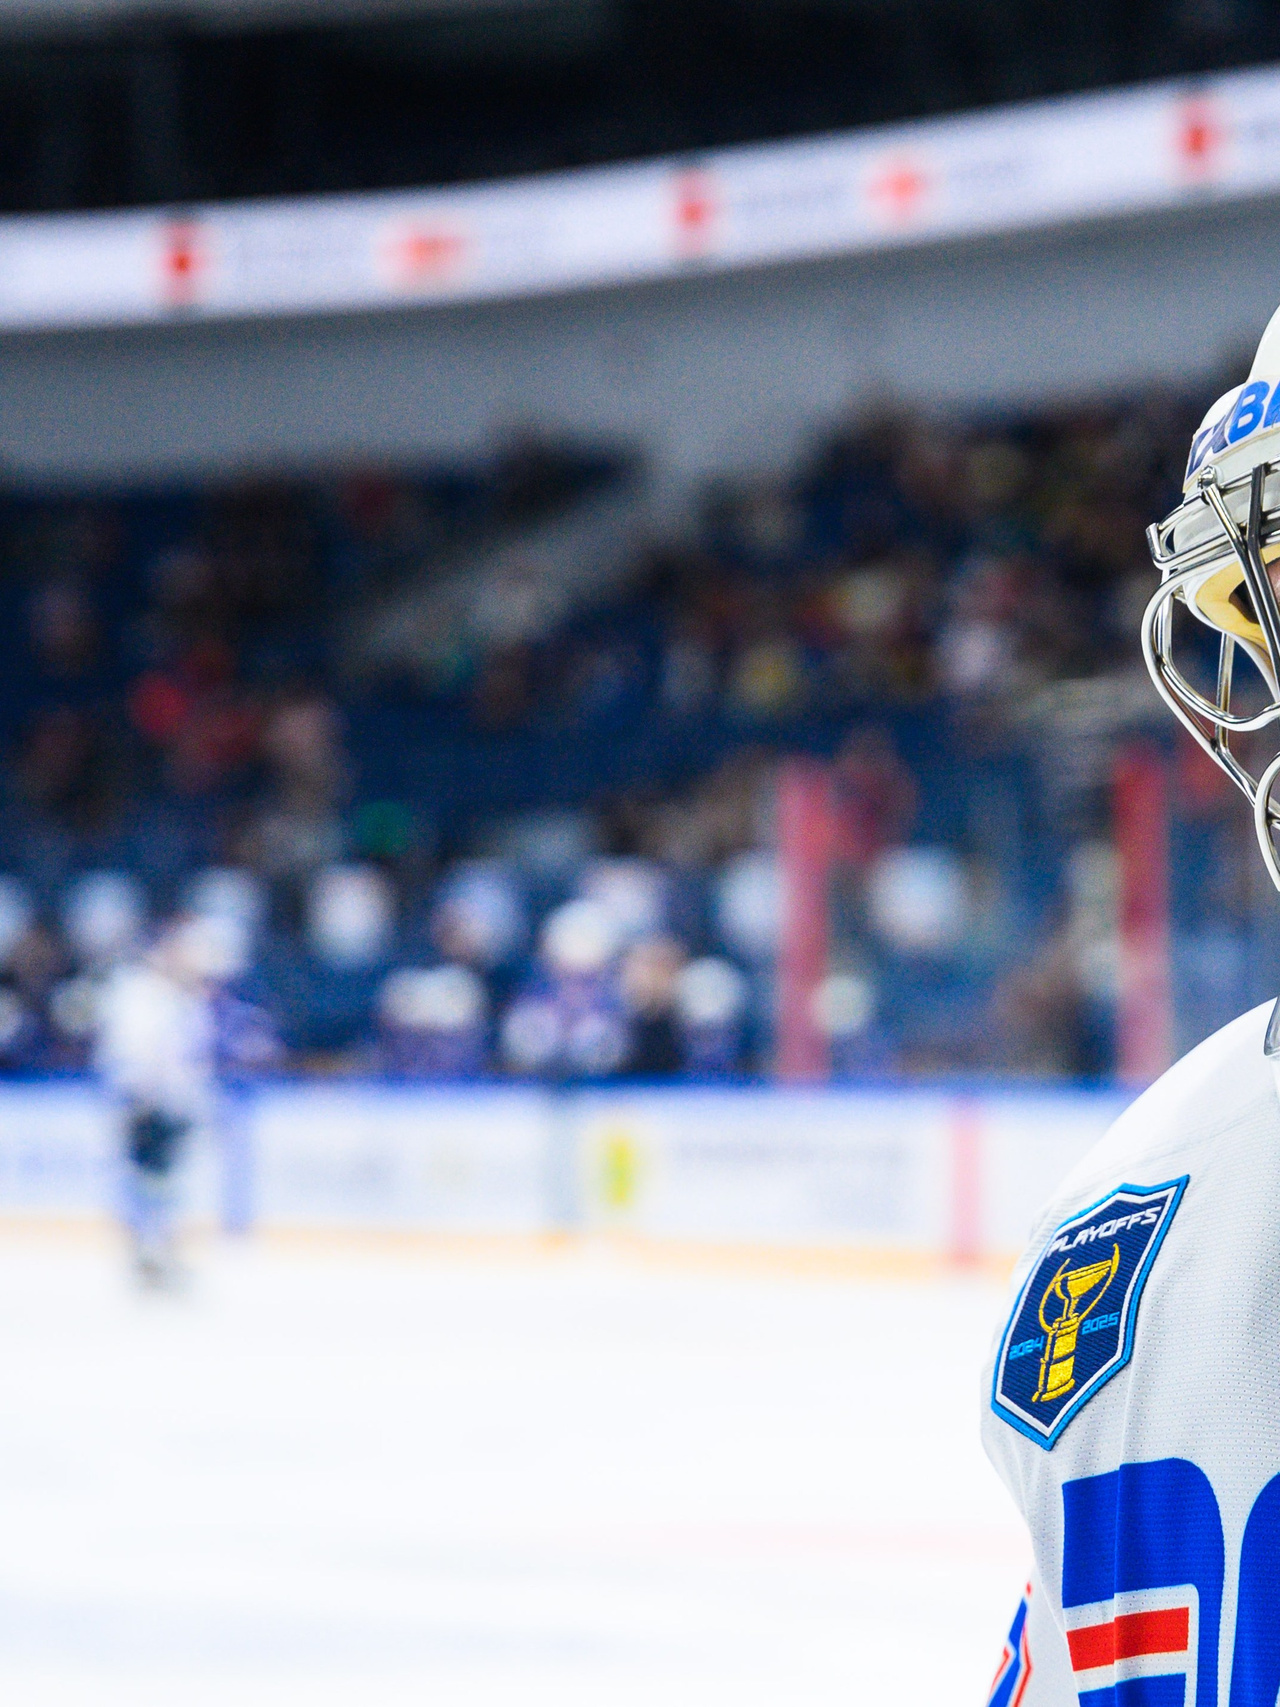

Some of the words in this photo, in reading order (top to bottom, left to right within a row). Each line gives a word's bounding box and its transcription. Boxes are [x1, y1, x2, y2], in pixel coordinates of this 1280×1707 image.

[1046, 1206, 1162, 1258] PLAYOFFS
[1081, 1311, 1120, 1336] 2025
[1008, 1335, 1045, 1360] 2024
